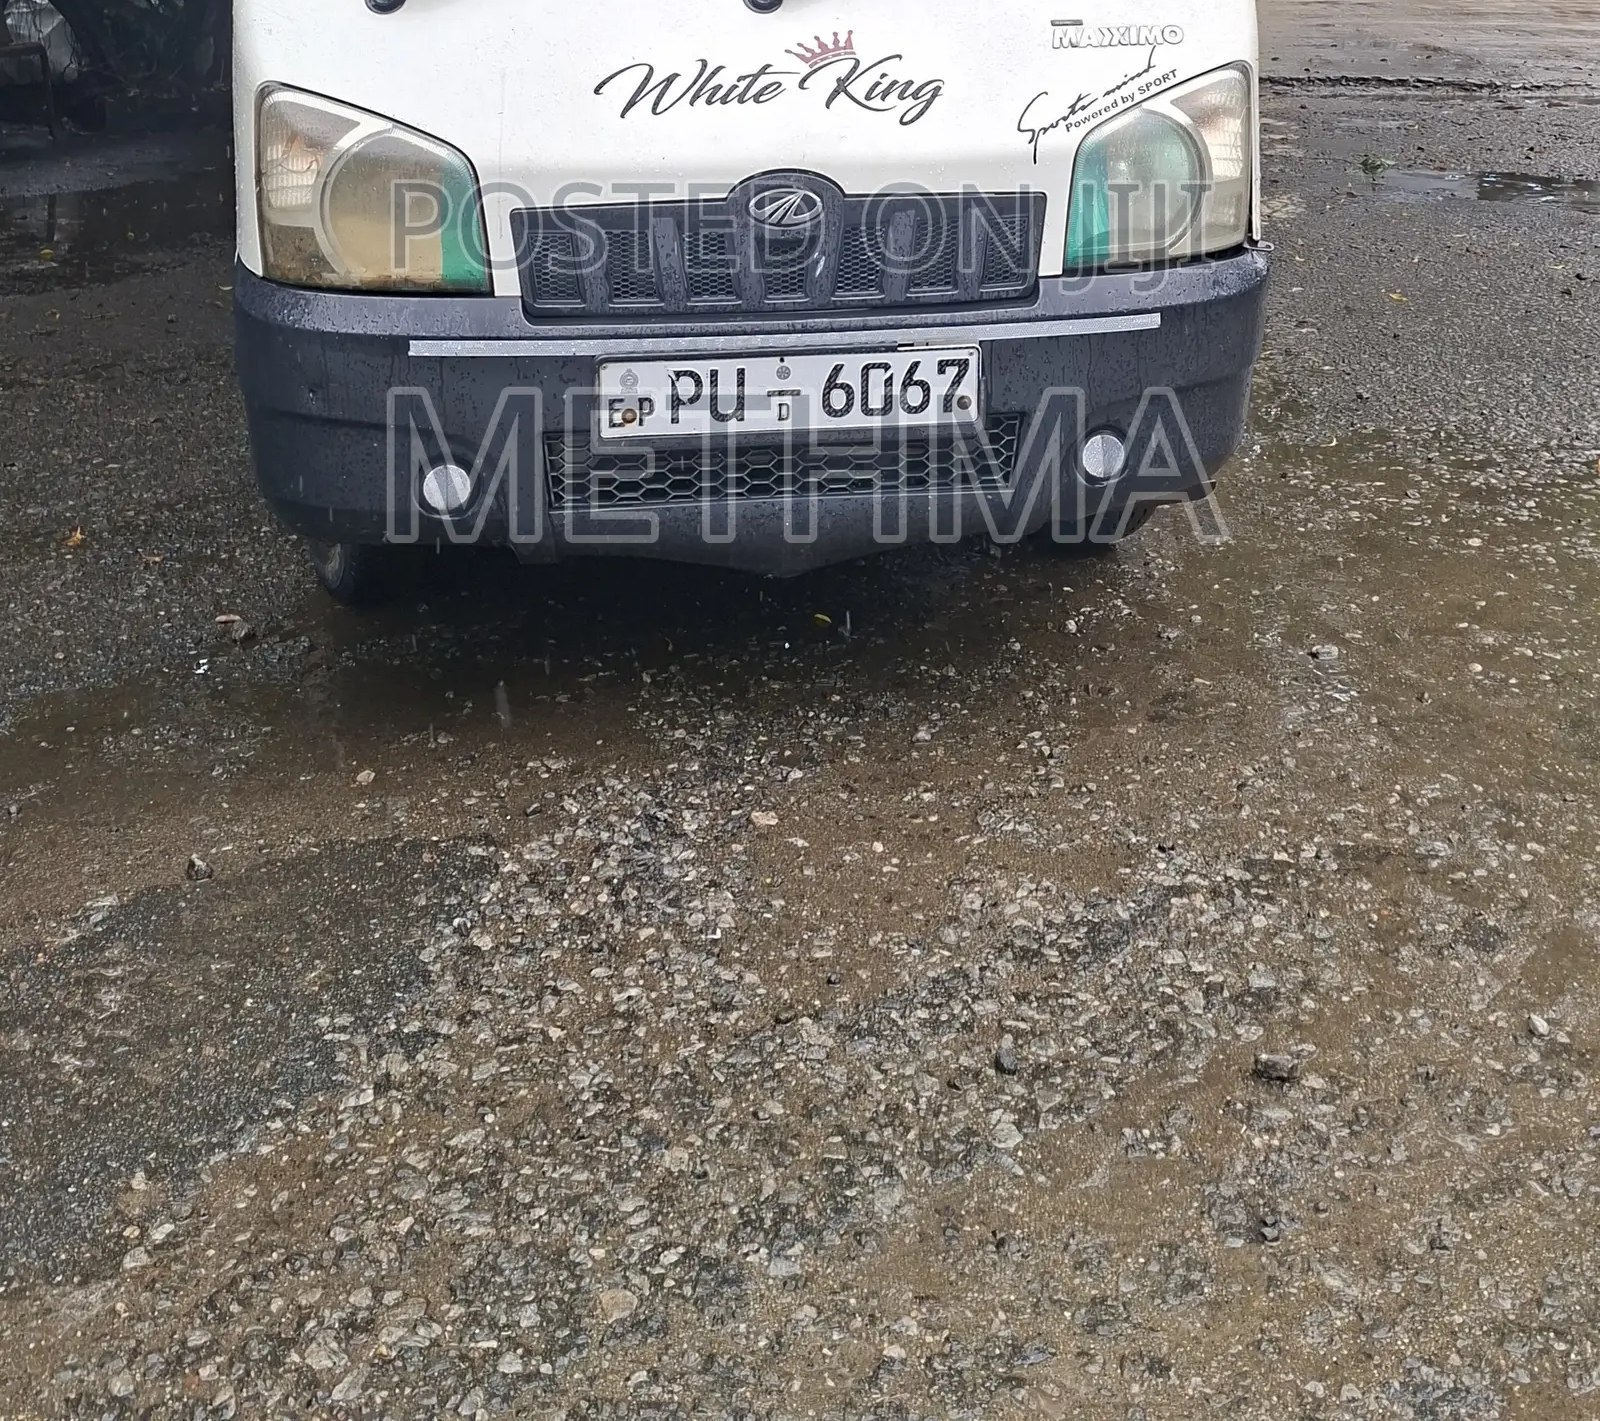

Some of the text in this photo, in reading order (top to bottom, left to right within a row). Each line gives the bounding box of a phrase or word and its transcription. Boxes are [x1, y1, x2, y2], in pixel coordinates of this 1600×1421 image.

[593, 54, 945, 126] White King
[1065, 69, 1179, 133] Powered by SPORT
[666, 358, 971, 425] PU 6067
